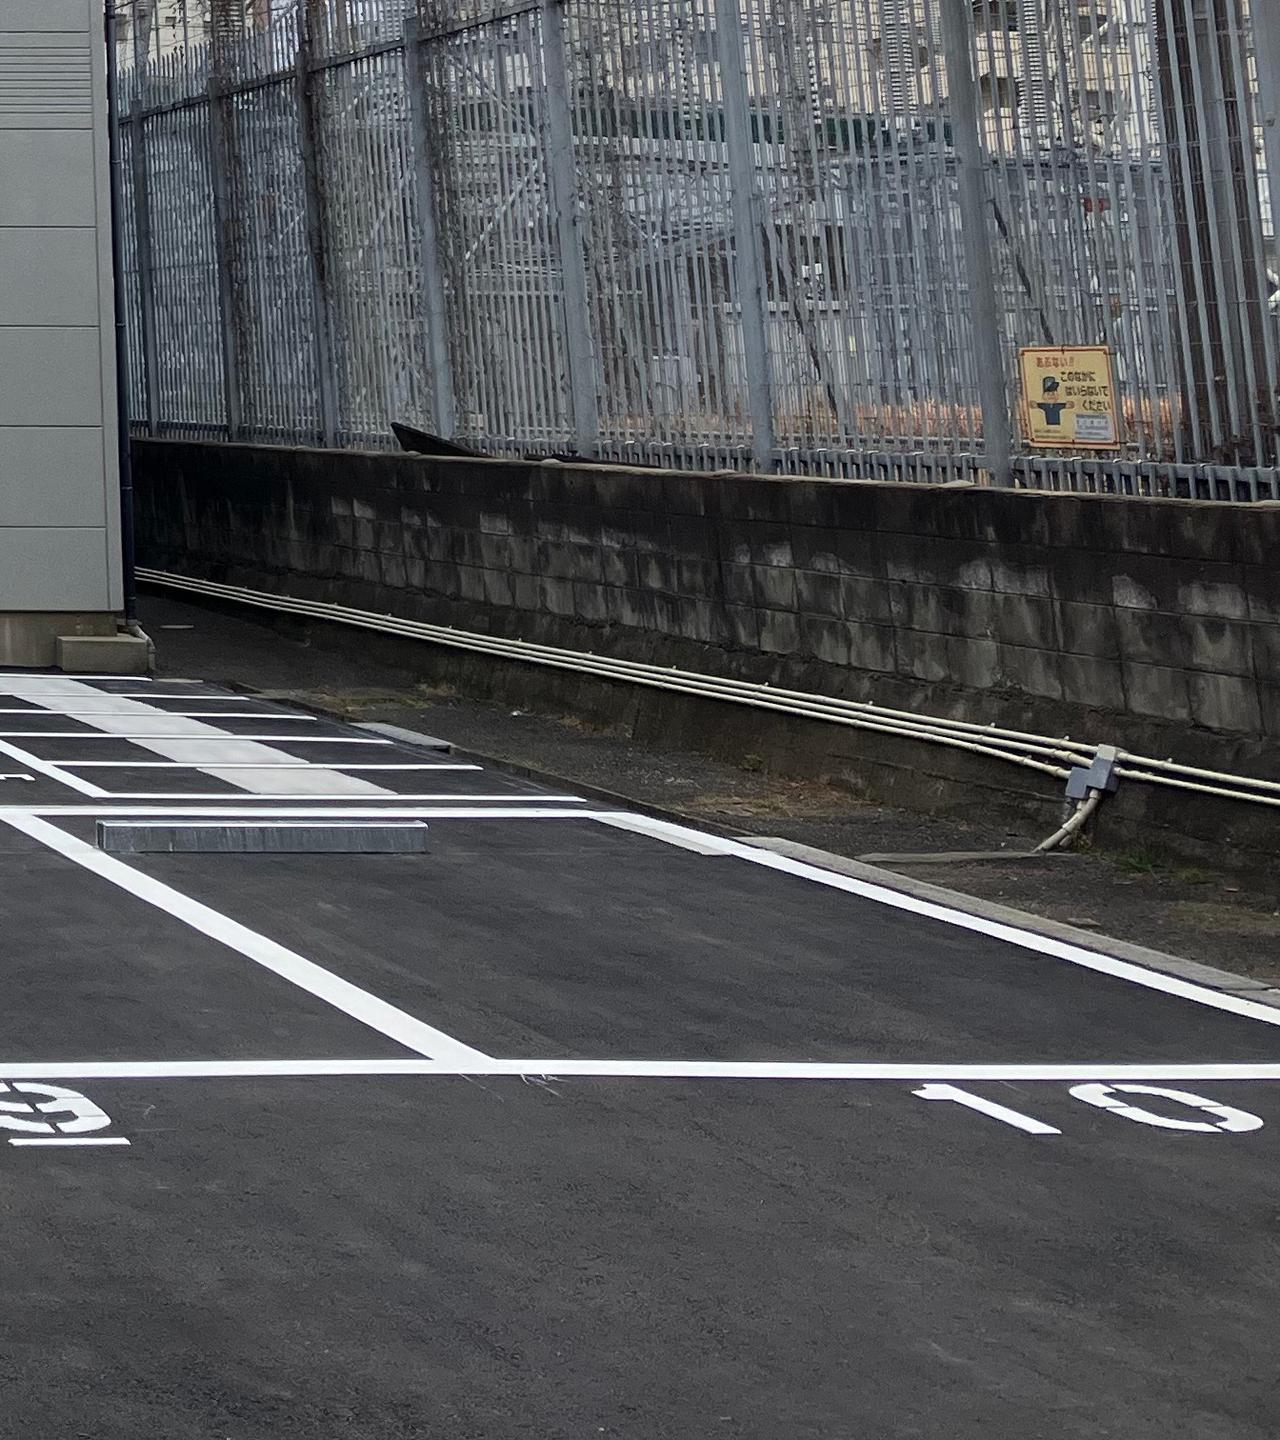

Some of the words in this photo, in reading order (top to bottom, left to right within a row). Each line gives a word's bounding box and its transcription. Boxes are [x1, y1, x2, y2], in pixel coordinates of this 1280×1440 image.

[1082, 399, 1112, 412] ください
[910, 1082, 1265, 1135] 10
